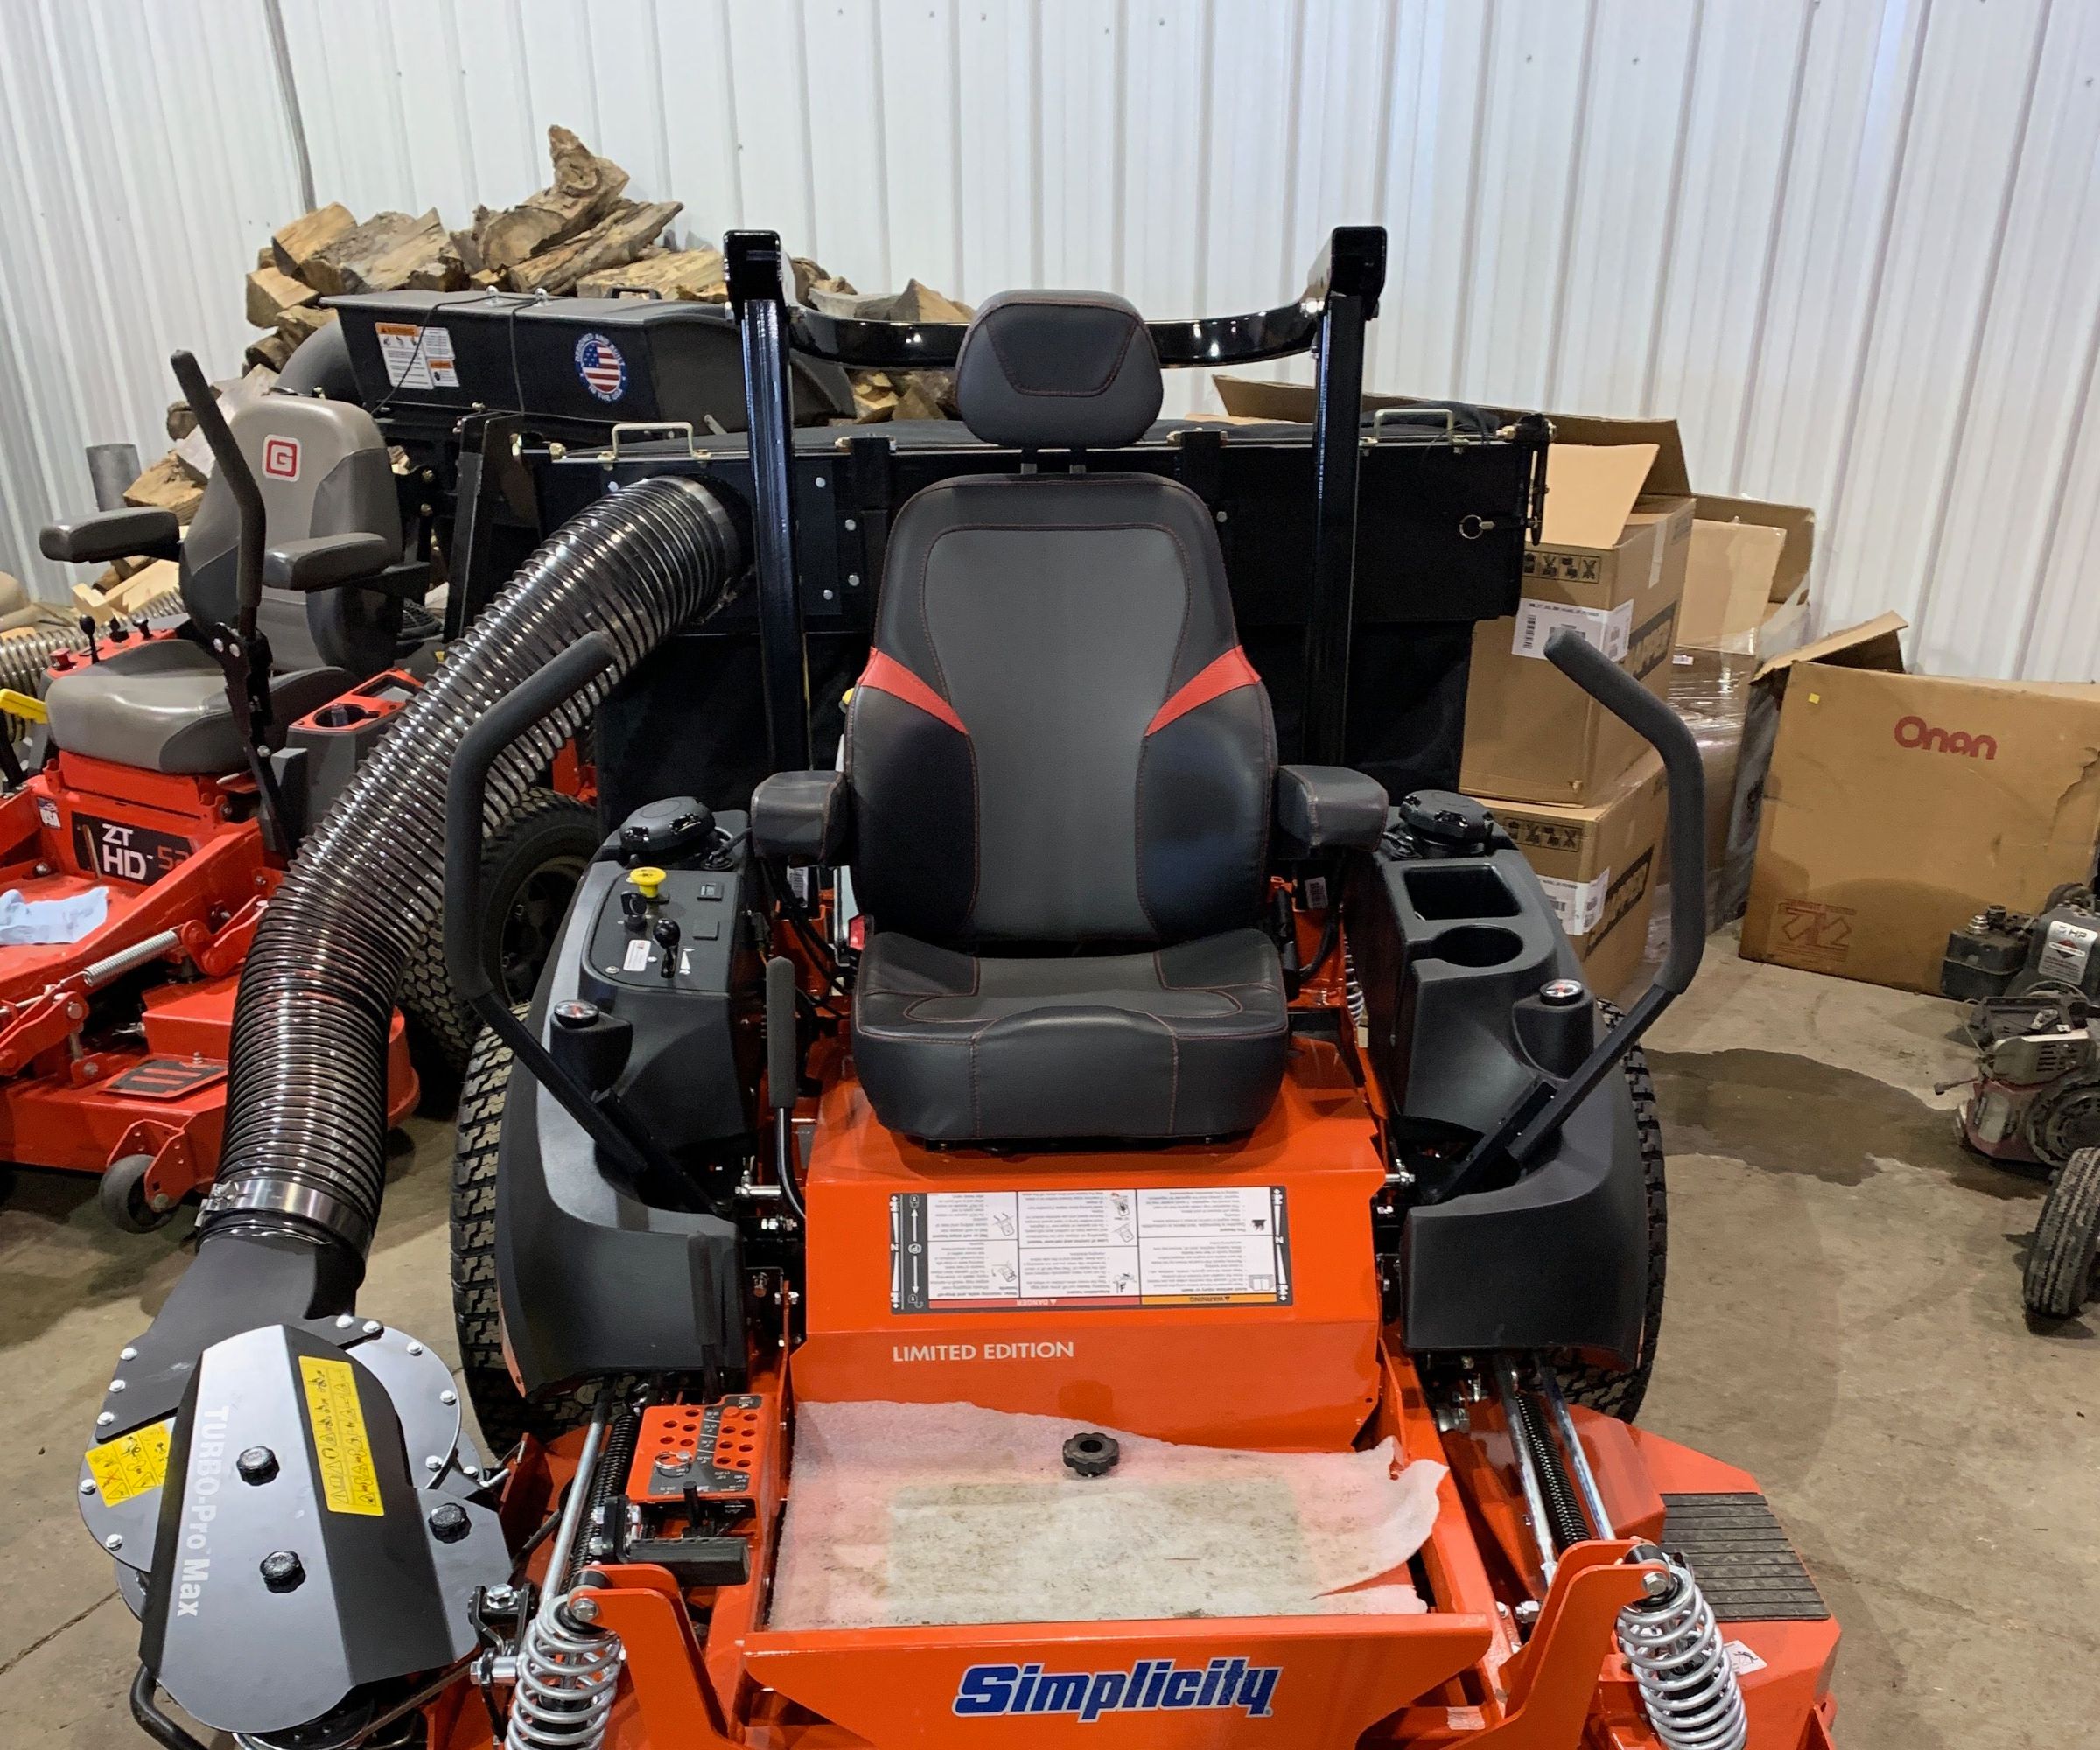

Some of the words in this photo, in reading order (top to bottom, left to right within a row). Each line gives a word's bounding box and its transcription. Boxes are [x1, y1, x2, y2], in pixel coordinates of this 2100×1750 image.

[269, 443, 295, 473] G
[1894, 716, 1997, 760] Onan
[102, 823, 134, 846] ZT
[2068, 929, 2087, 938] HP
[892, 1344, 976, 1362] LIMITED
[984, 1341, 1074, 1360] EDITION
[186, 1406, 229, 1550] TURBO-Pro
[177, 1558, 211, 1617] Max
[952, 1656, 1283, 1722] Simplicity
